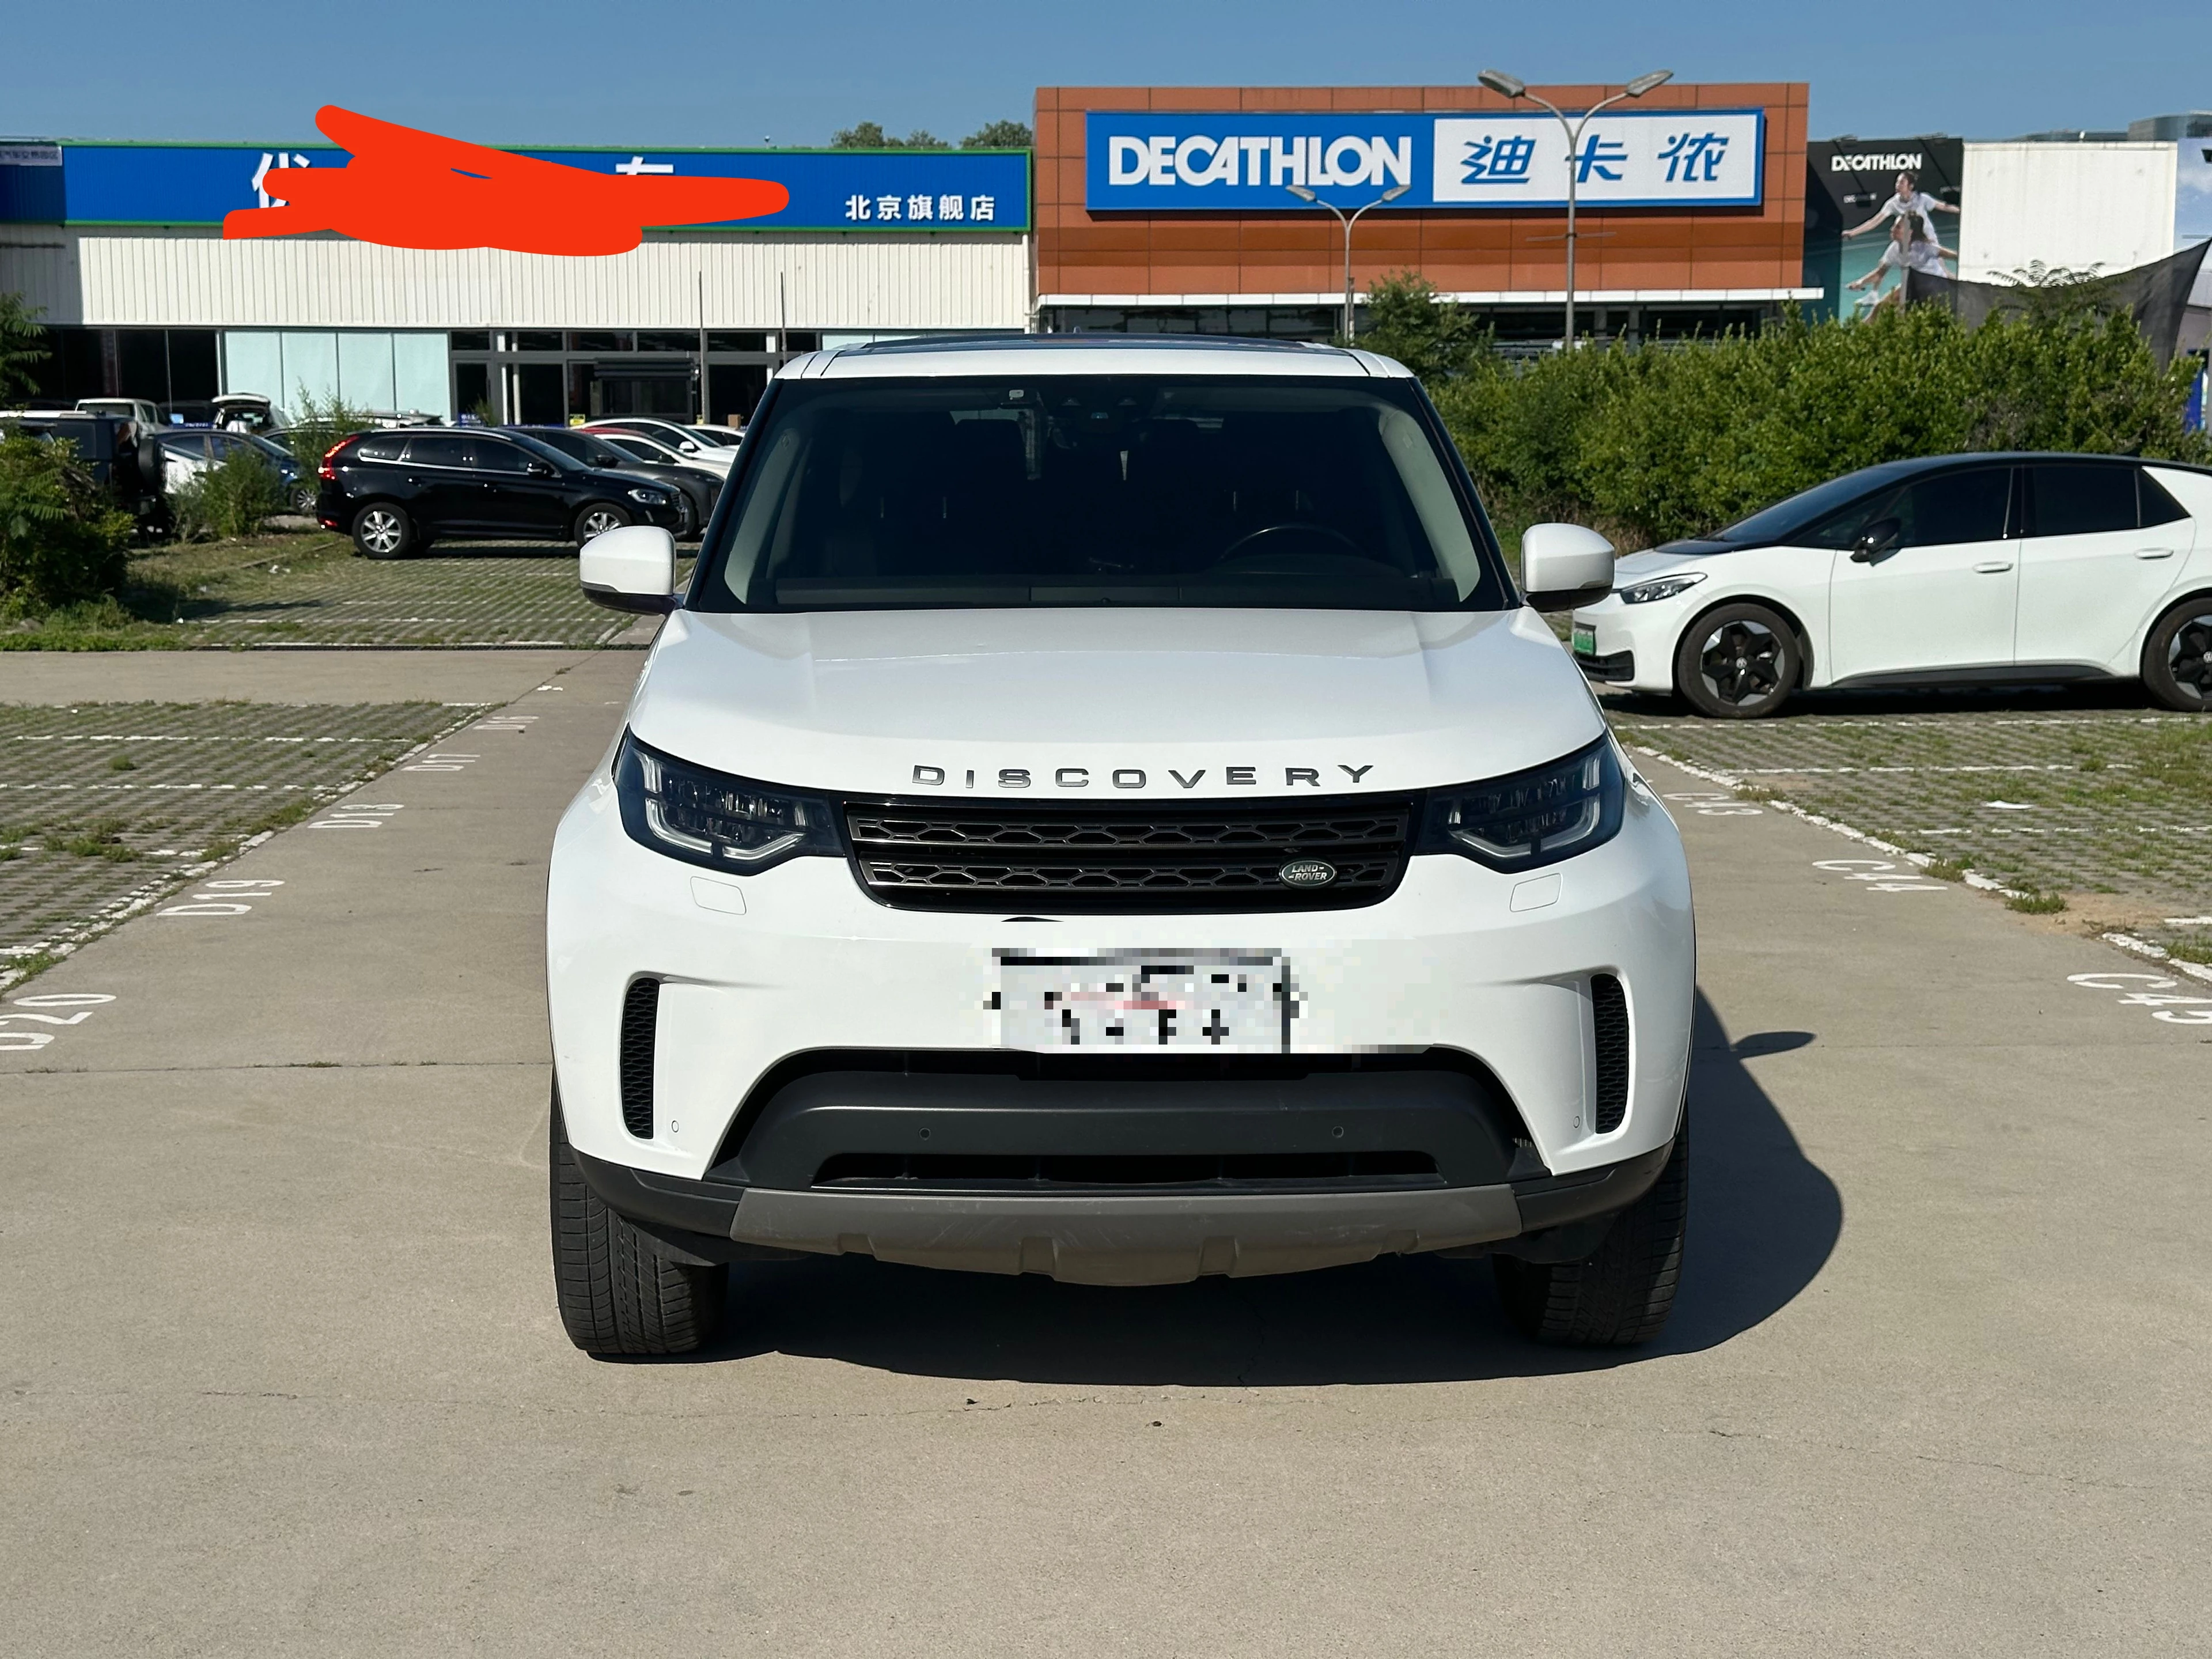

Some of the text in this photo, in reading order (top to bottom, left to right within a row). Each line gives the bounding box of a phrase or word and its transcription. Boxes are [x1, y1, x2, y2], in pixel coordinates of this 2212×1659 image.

[1109, 136, 1411, 185] DECATHLON
[1460, 132, 1729, 184] 迪卡侬
[1831, 153, 1922, 171] DECATHLON
[845, 194, 994, 221] 北京旗舰店
[402, 753, 480, 772] D17
[912, 764, 1374, 789] DISCOVERY
[1662, 791, 1763, 816] C43
[1291, 865, 1318, 873] LAND
[1294, 873, 1327, 881] ROVER
[1812, 859, 1948, 892] C44
[156, 879, 285, 916] D19
